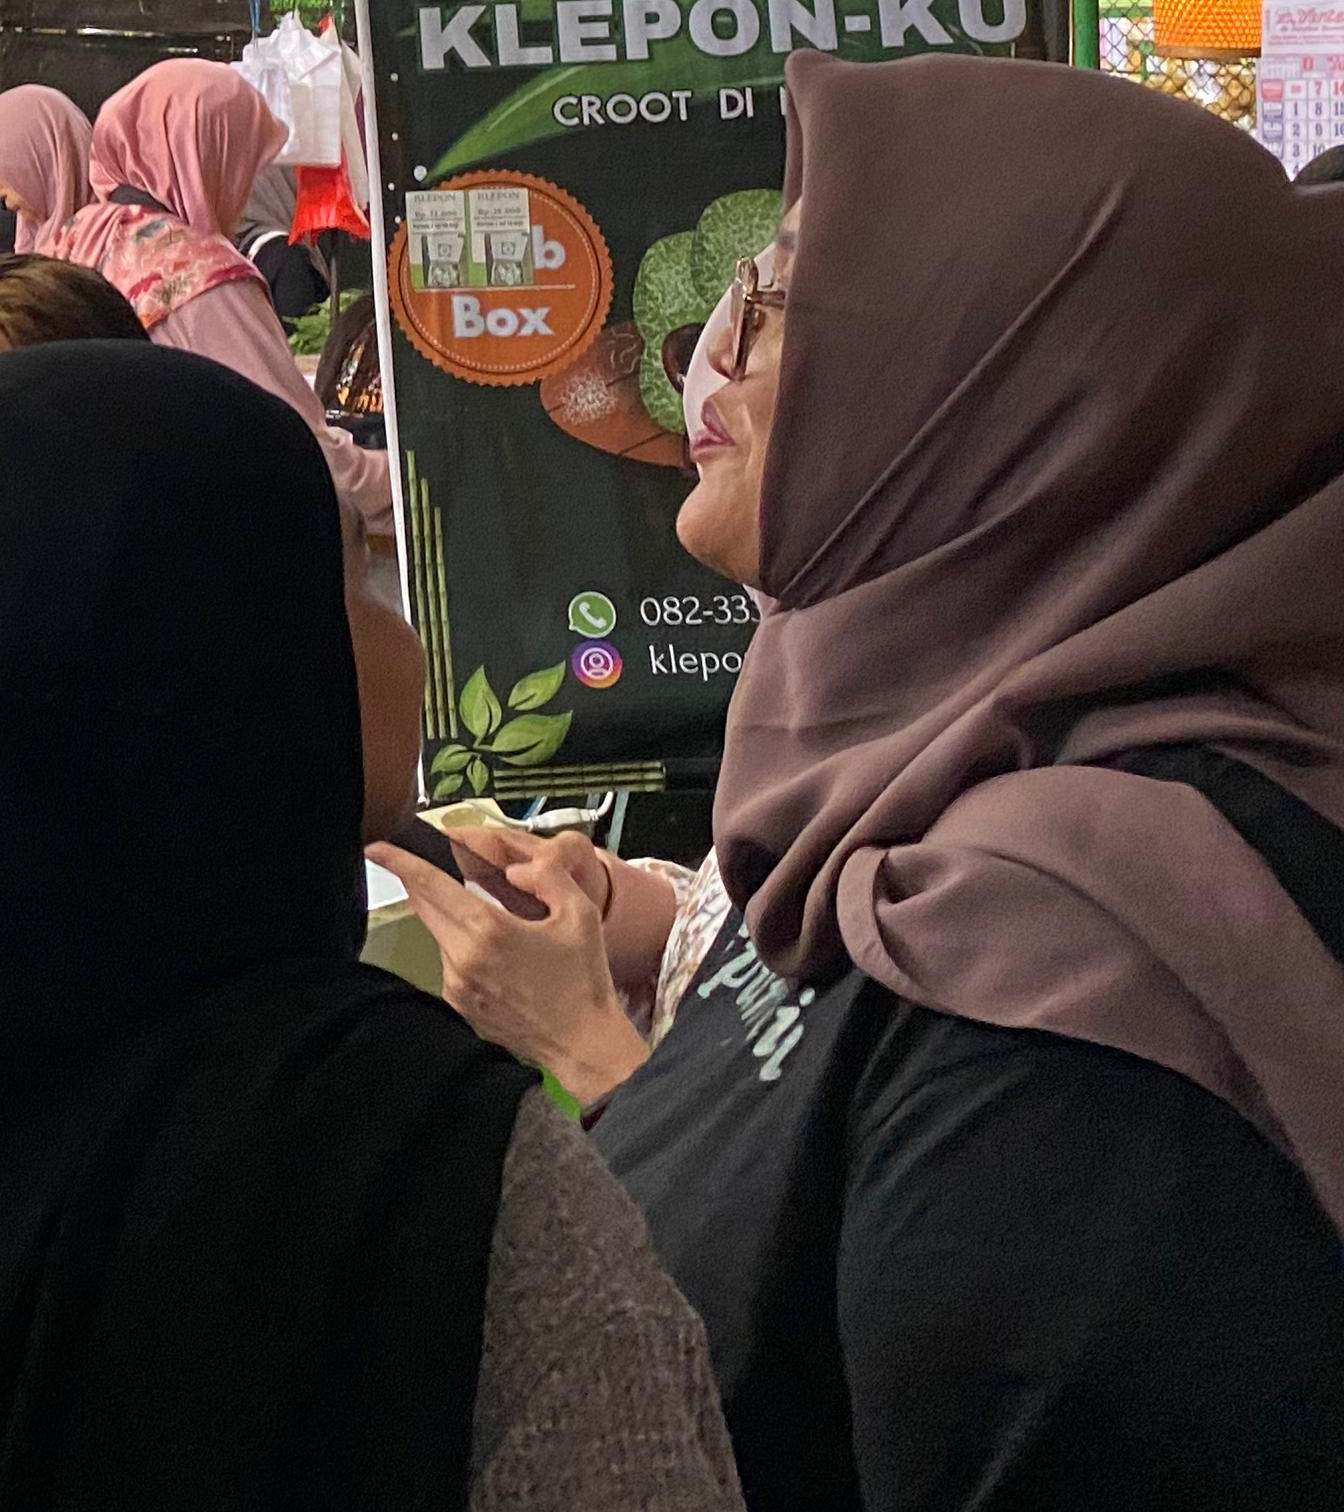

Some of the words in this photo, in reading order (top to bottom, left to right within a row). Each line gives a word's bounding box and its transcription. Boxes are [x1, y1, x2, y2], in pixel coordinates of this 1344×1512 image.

[553, 89, 692, 128] CROOT
[719, 87, 754, 120] DI
[451, 294, 556, 339] Box
